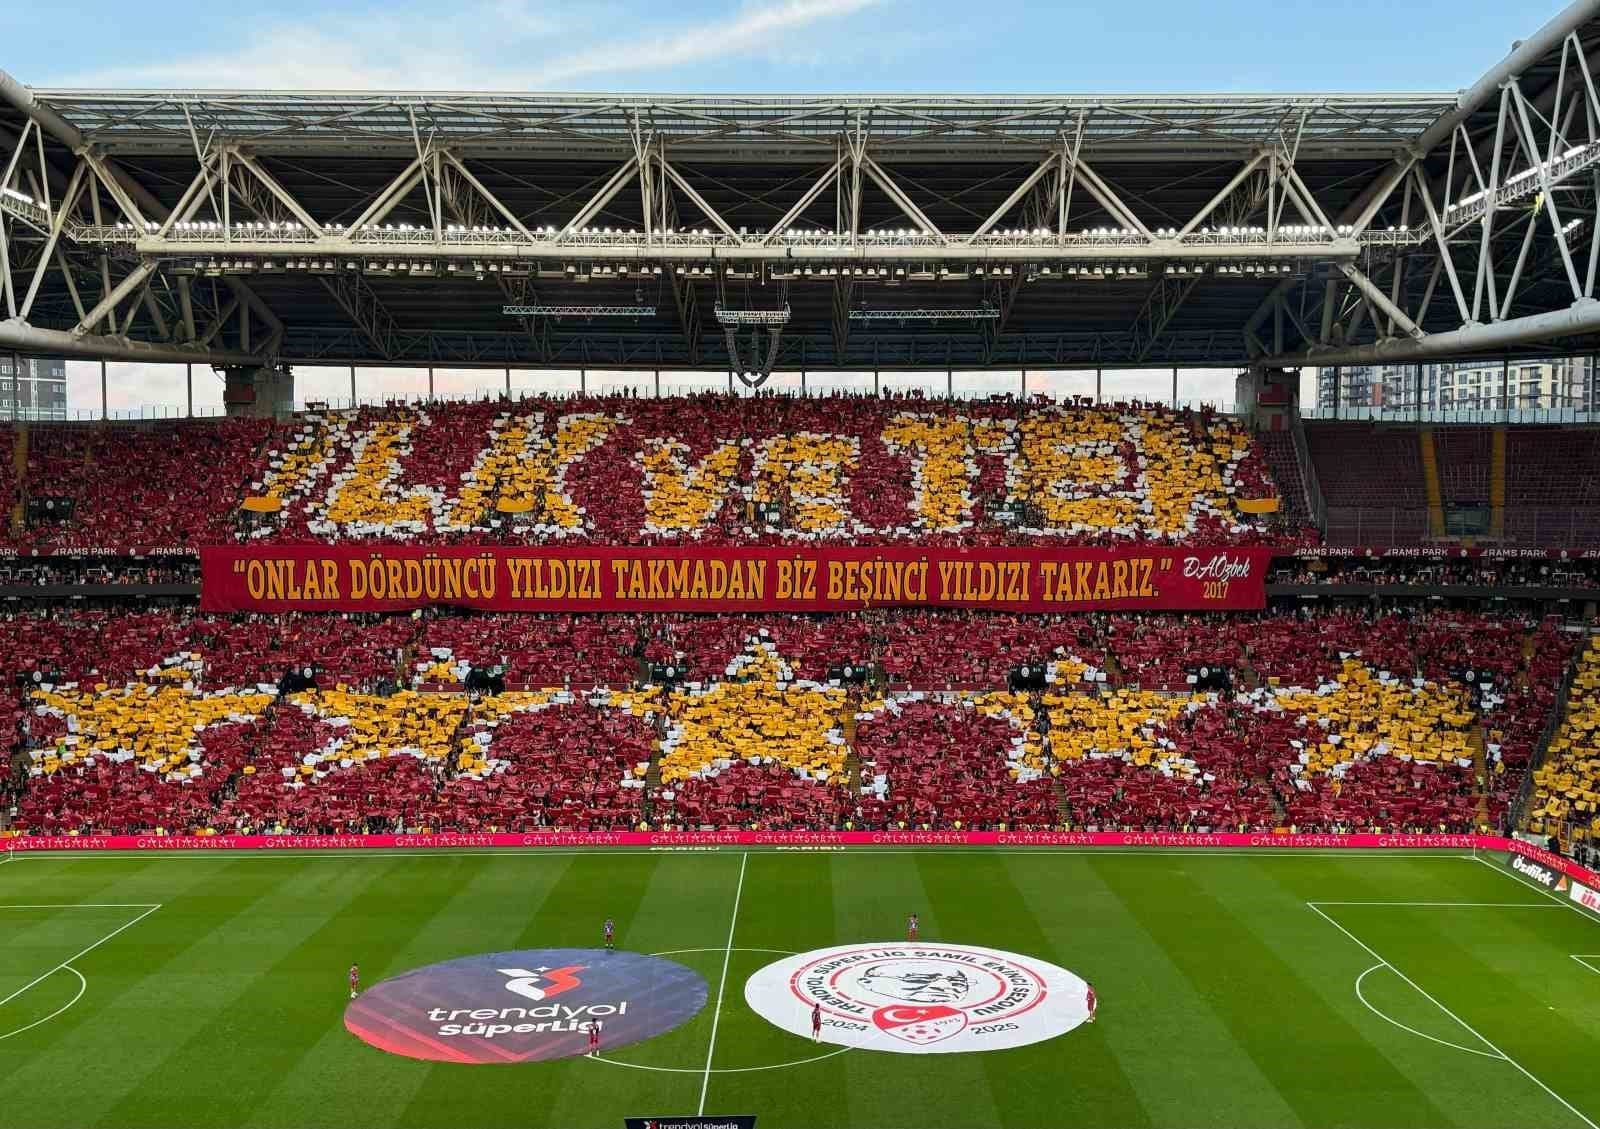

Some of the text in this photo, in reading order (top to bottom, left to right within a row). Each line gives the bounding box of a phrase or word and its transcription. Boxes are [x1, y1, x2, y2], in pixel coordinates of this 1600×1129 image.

[60, 548, 117, 556] RAMS PARK
[186, 548, 199, 556] PA
[1488, 549, 1547, 557] RAMS PARK
[349, 553, 497, 600] DÖRDÜNCÜ
[507, 559, 602, 600] YILDIZI
[612, 559, 767, 600] TAKMADAN
[775, 554, 817, 600] BİZ
[827, 555, 929, 608] BEŞİNCİ
[938, 560, 1031, 601] YILDIZI
[1203, 581, 1229, 599] 2017
[806, 976, 867, 1015] TRENDYOL
[972, 986, 1031, 1017] SEZONU
[427, 1001, 627, 1022] trendyol
[820, 1018, 869, 1032] 2024
[970, 1022, 1020, 1035] 2025
